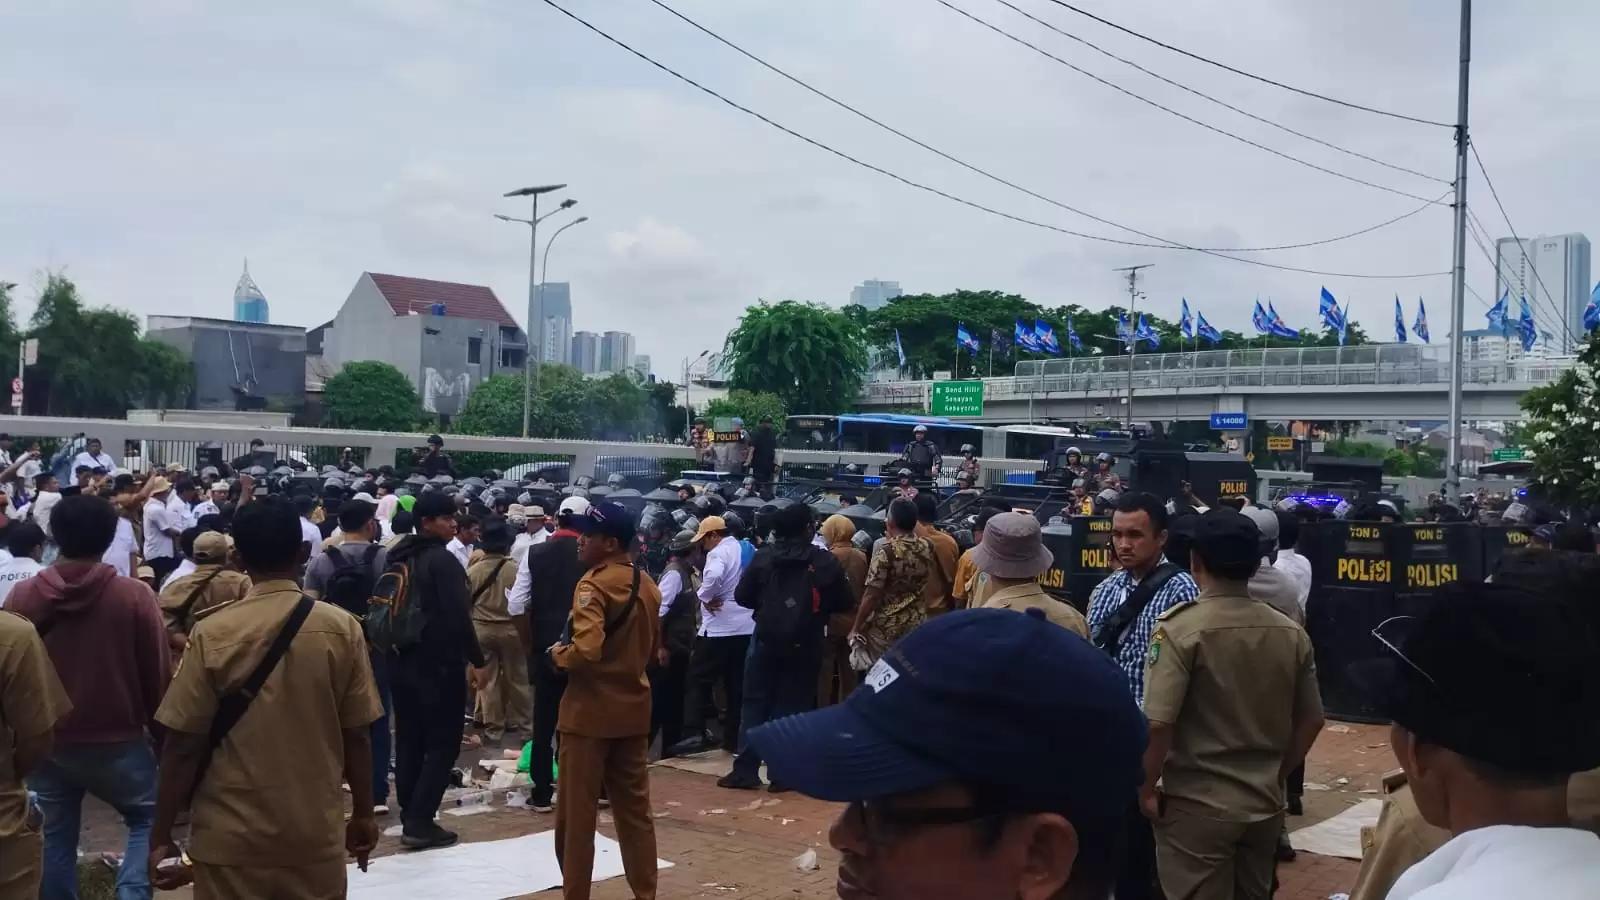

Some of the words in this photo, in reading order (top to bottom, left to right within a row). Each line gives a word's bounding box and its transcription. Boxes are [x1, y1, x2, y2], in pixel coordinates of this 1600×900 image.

[716, 433, 739, 441] POLISI
[1220, 482, 1247, 493] POLISI
[1350, 527, 1370, 538] YON
[1415, 529, 1434, 540] YON
[1338, 558, 1392, 582] POLISI
[1407, 564, 1458, 587] POLISI
